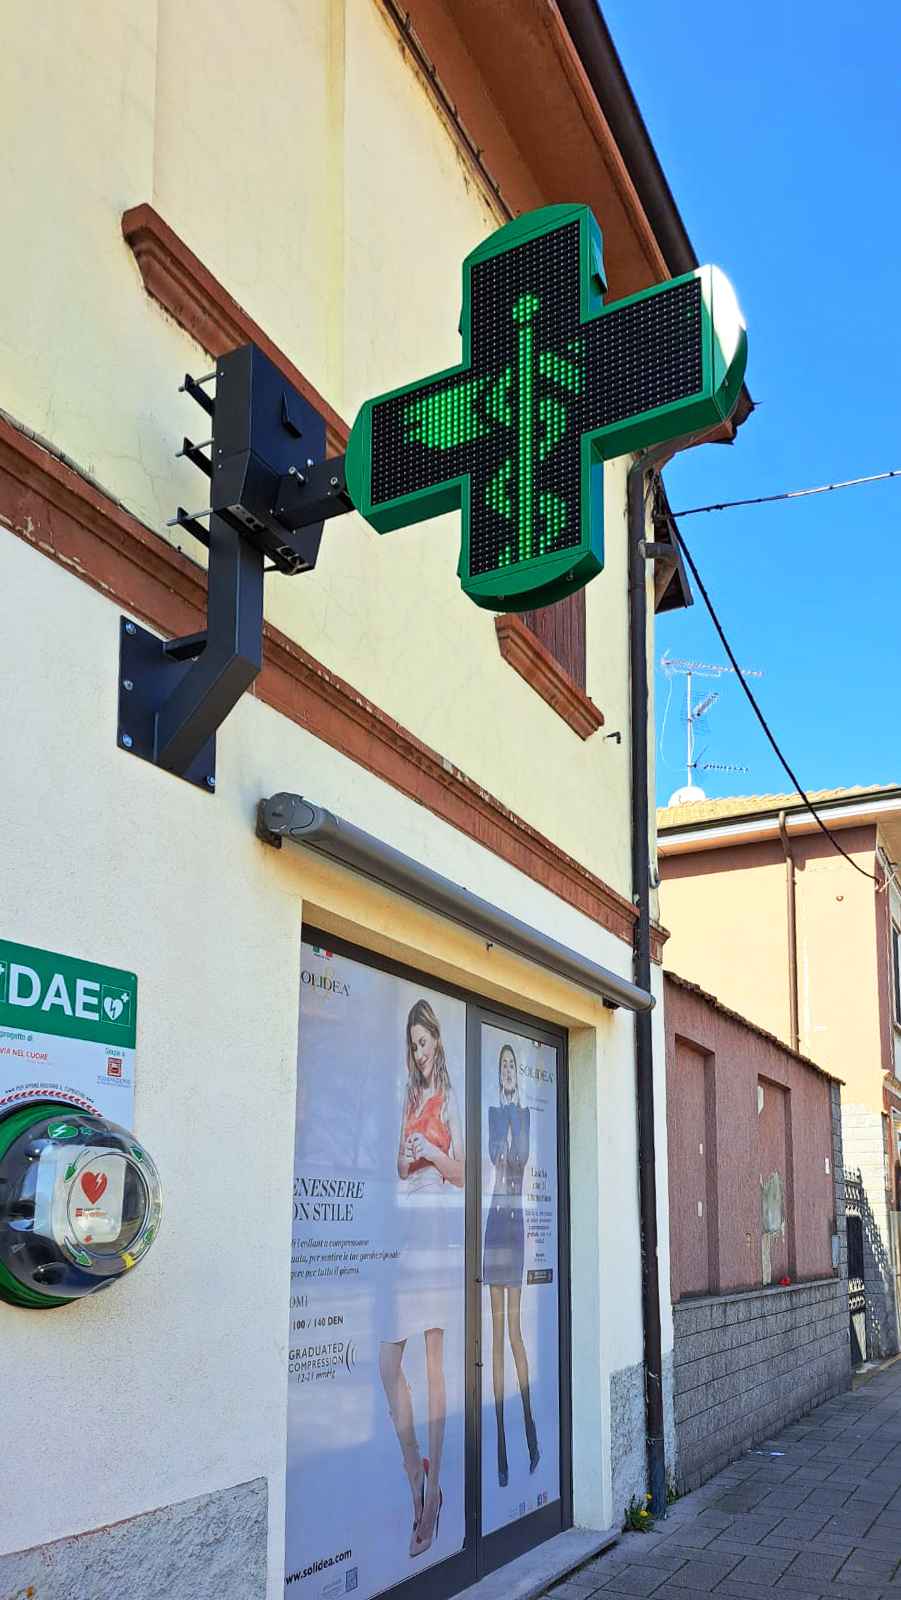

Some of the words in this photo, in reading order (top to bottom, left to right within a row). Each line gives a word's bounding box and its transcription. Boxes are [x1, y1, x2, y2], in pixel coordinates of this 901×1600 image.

[9, 963, 100, 1020] DAE
[12, 1049, 23, 1057] NEL
[26, 1051, 48, 1060] CUORE
[312, 1203, 354, 1222] STILE
[293, 1320, 306, 1331] 100
[327, 1315, 344, 1326] DEN
[288, 1342, 344, 1361] GRADUATED
[288, 1355, 344, 1373] COMPRESSION
